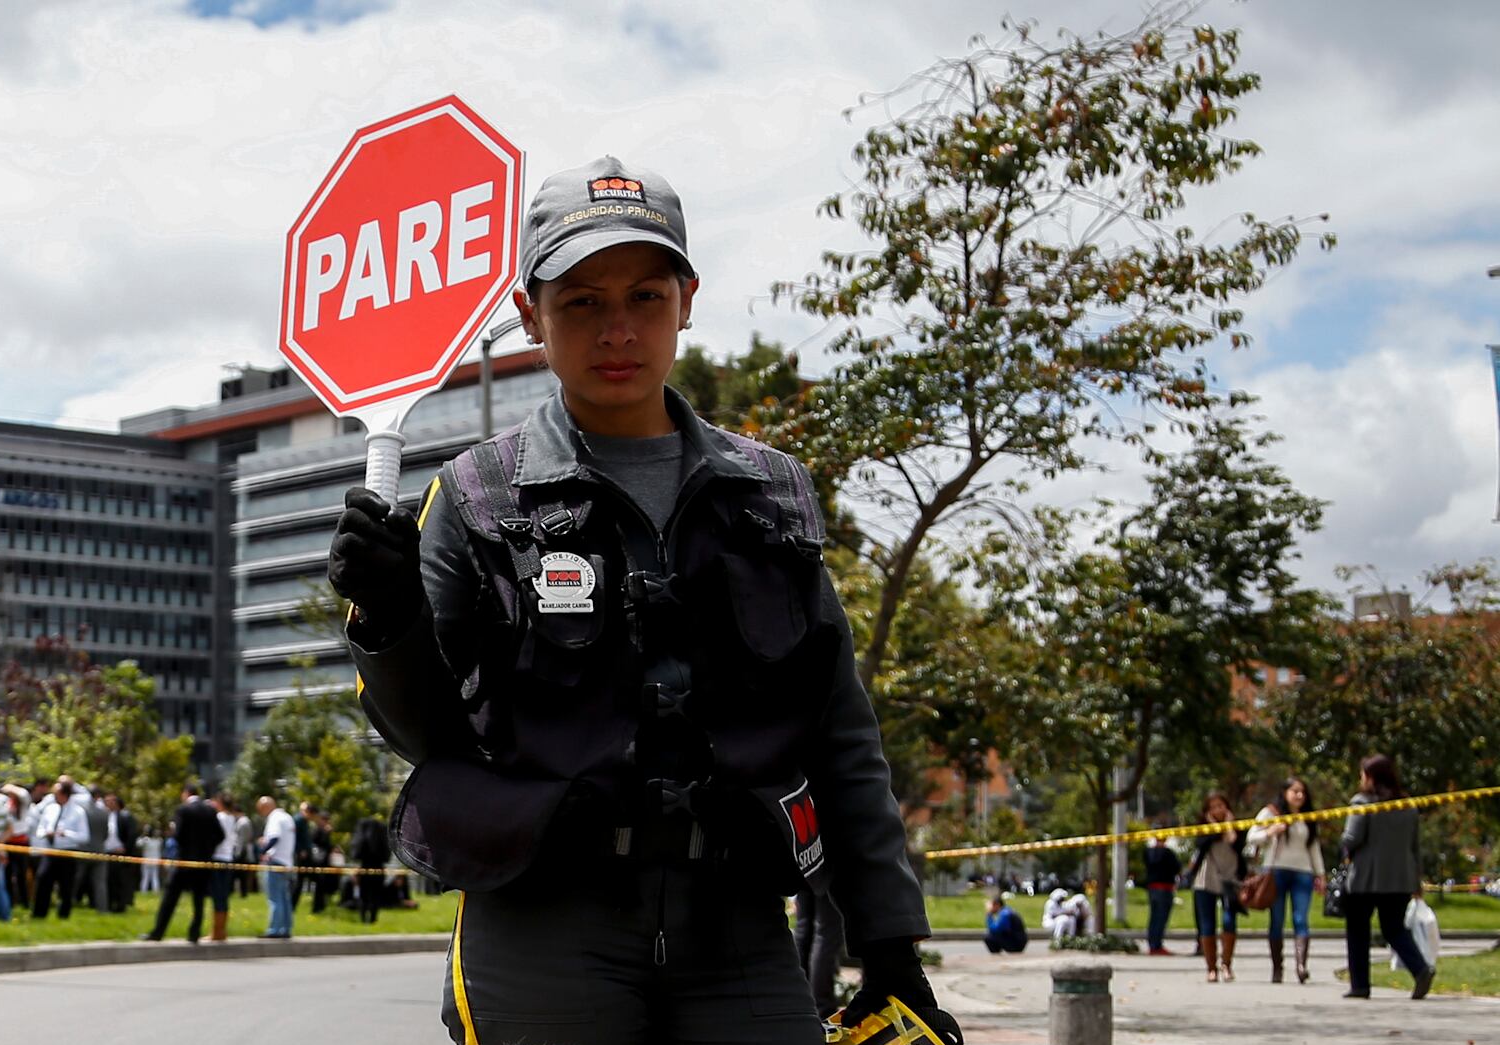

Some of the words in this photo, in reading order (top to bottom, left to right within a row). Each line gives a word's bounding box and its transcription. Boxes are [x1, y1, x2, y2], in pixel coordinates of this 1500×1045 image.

[593, 189, 641, 200] SECURITAS
[563, 205, 624, 225] SEGURIDAD
[627, 206, 668, 225] PRIVADA
[302, 181, 494, 333] PARE
